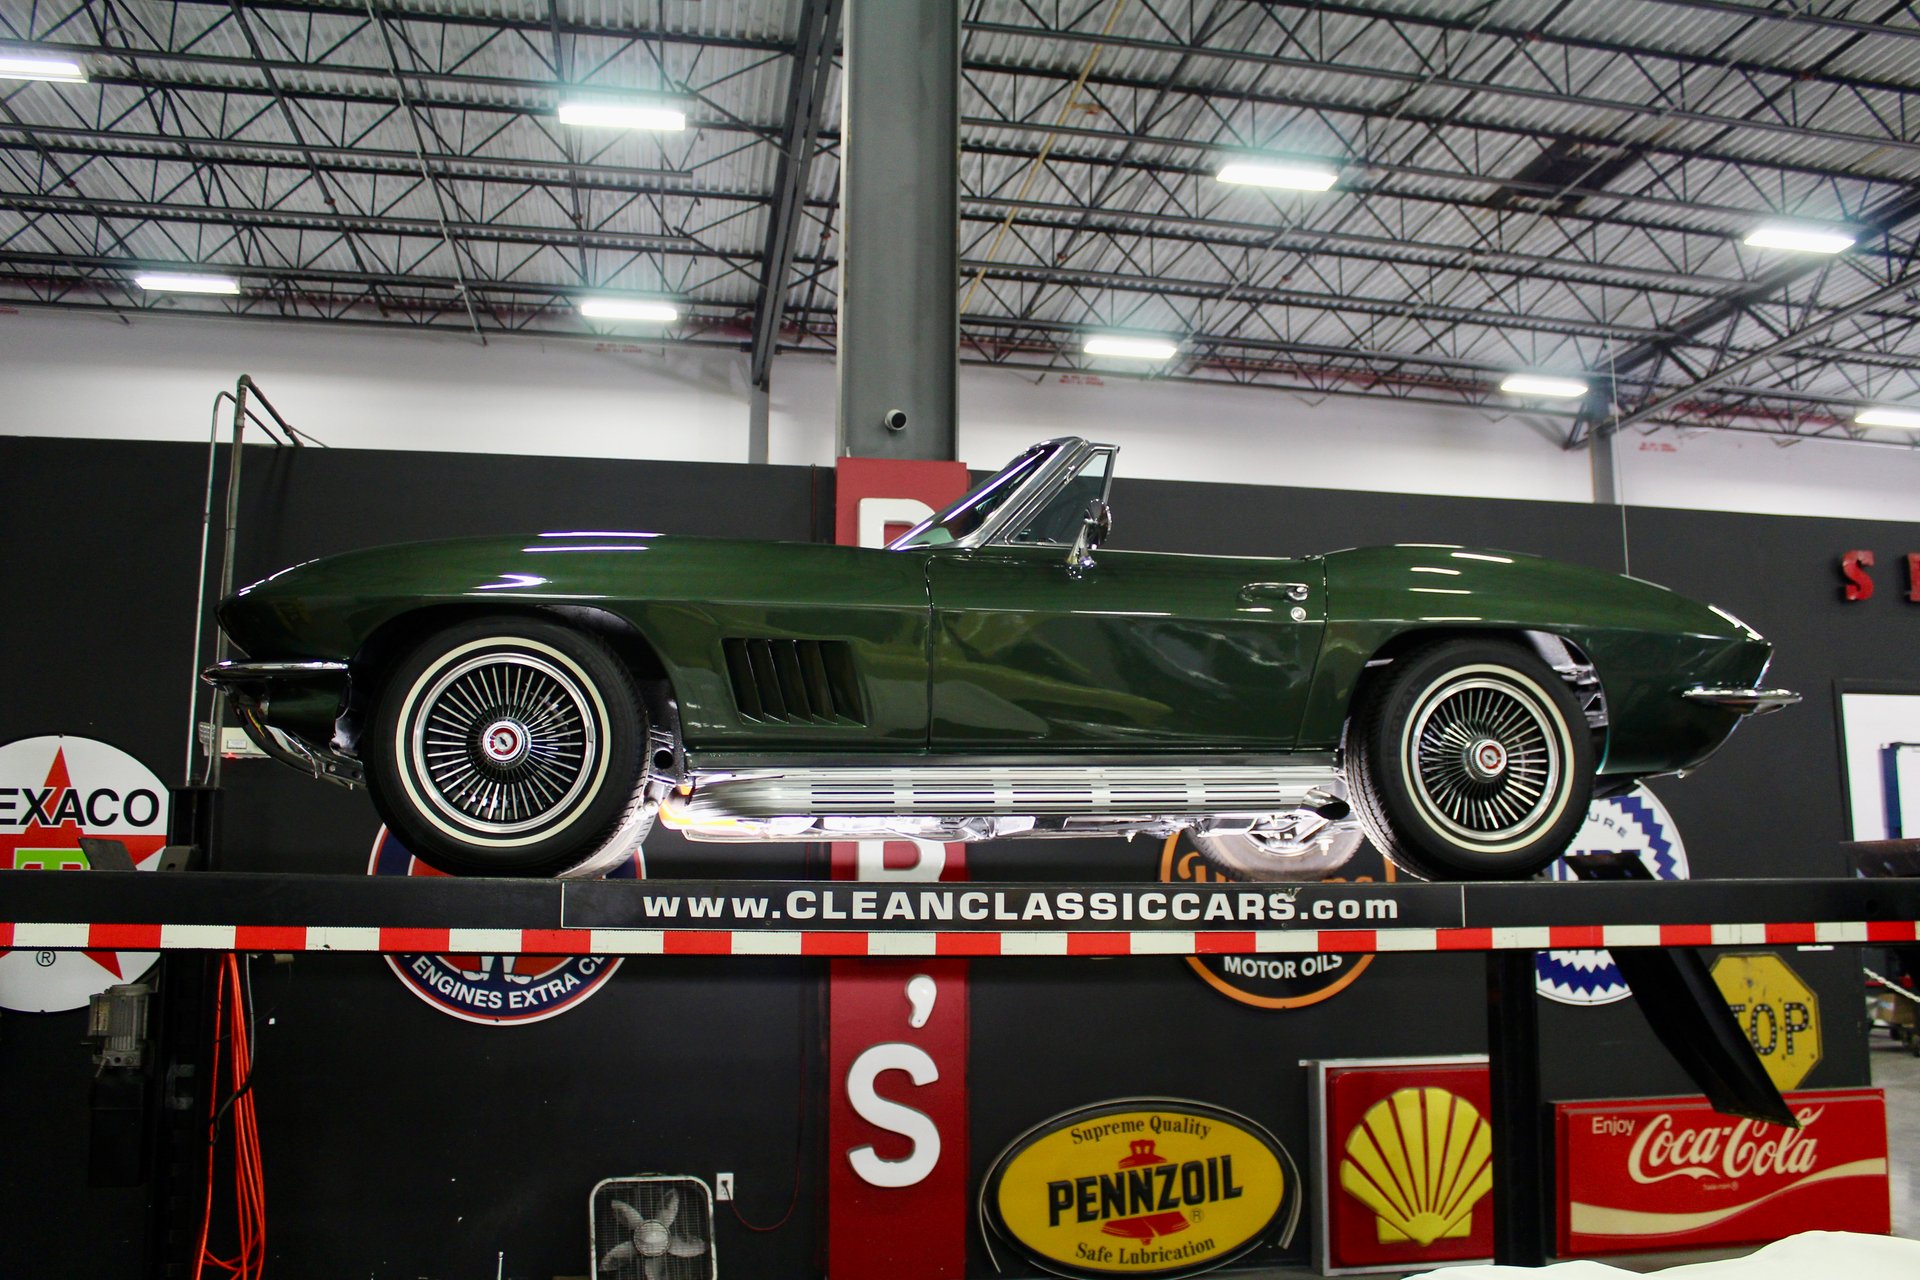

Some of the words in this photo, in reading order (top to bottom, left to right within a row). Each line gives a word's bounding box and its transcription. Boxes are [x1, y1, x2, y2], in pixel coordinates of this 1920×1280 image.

[642, 890, 1398, 921] www.CLEANCLASSICCARS.com
[1223, 955, 1297, 979] MOTOR
[1301, 954, 1343, 977] OILS
[411, 956, 503, 1009] ENGINES
[508, 975, 581, 1009] EXTRA
[1070, 1117, 1145, 1145] Supreme
[1149, 1115, 1212, 1140] Quality
[1592, 1116, 1635, 1136] Enjoy
[1628, 1104, 1825, 1184] Coca-Cola
[1046, 1154, 1244, 1227] PENNZOIL
[1075, 1242, 1113, 1263] Safe
[1118, 1236, 1216, 1265] Lubrication
